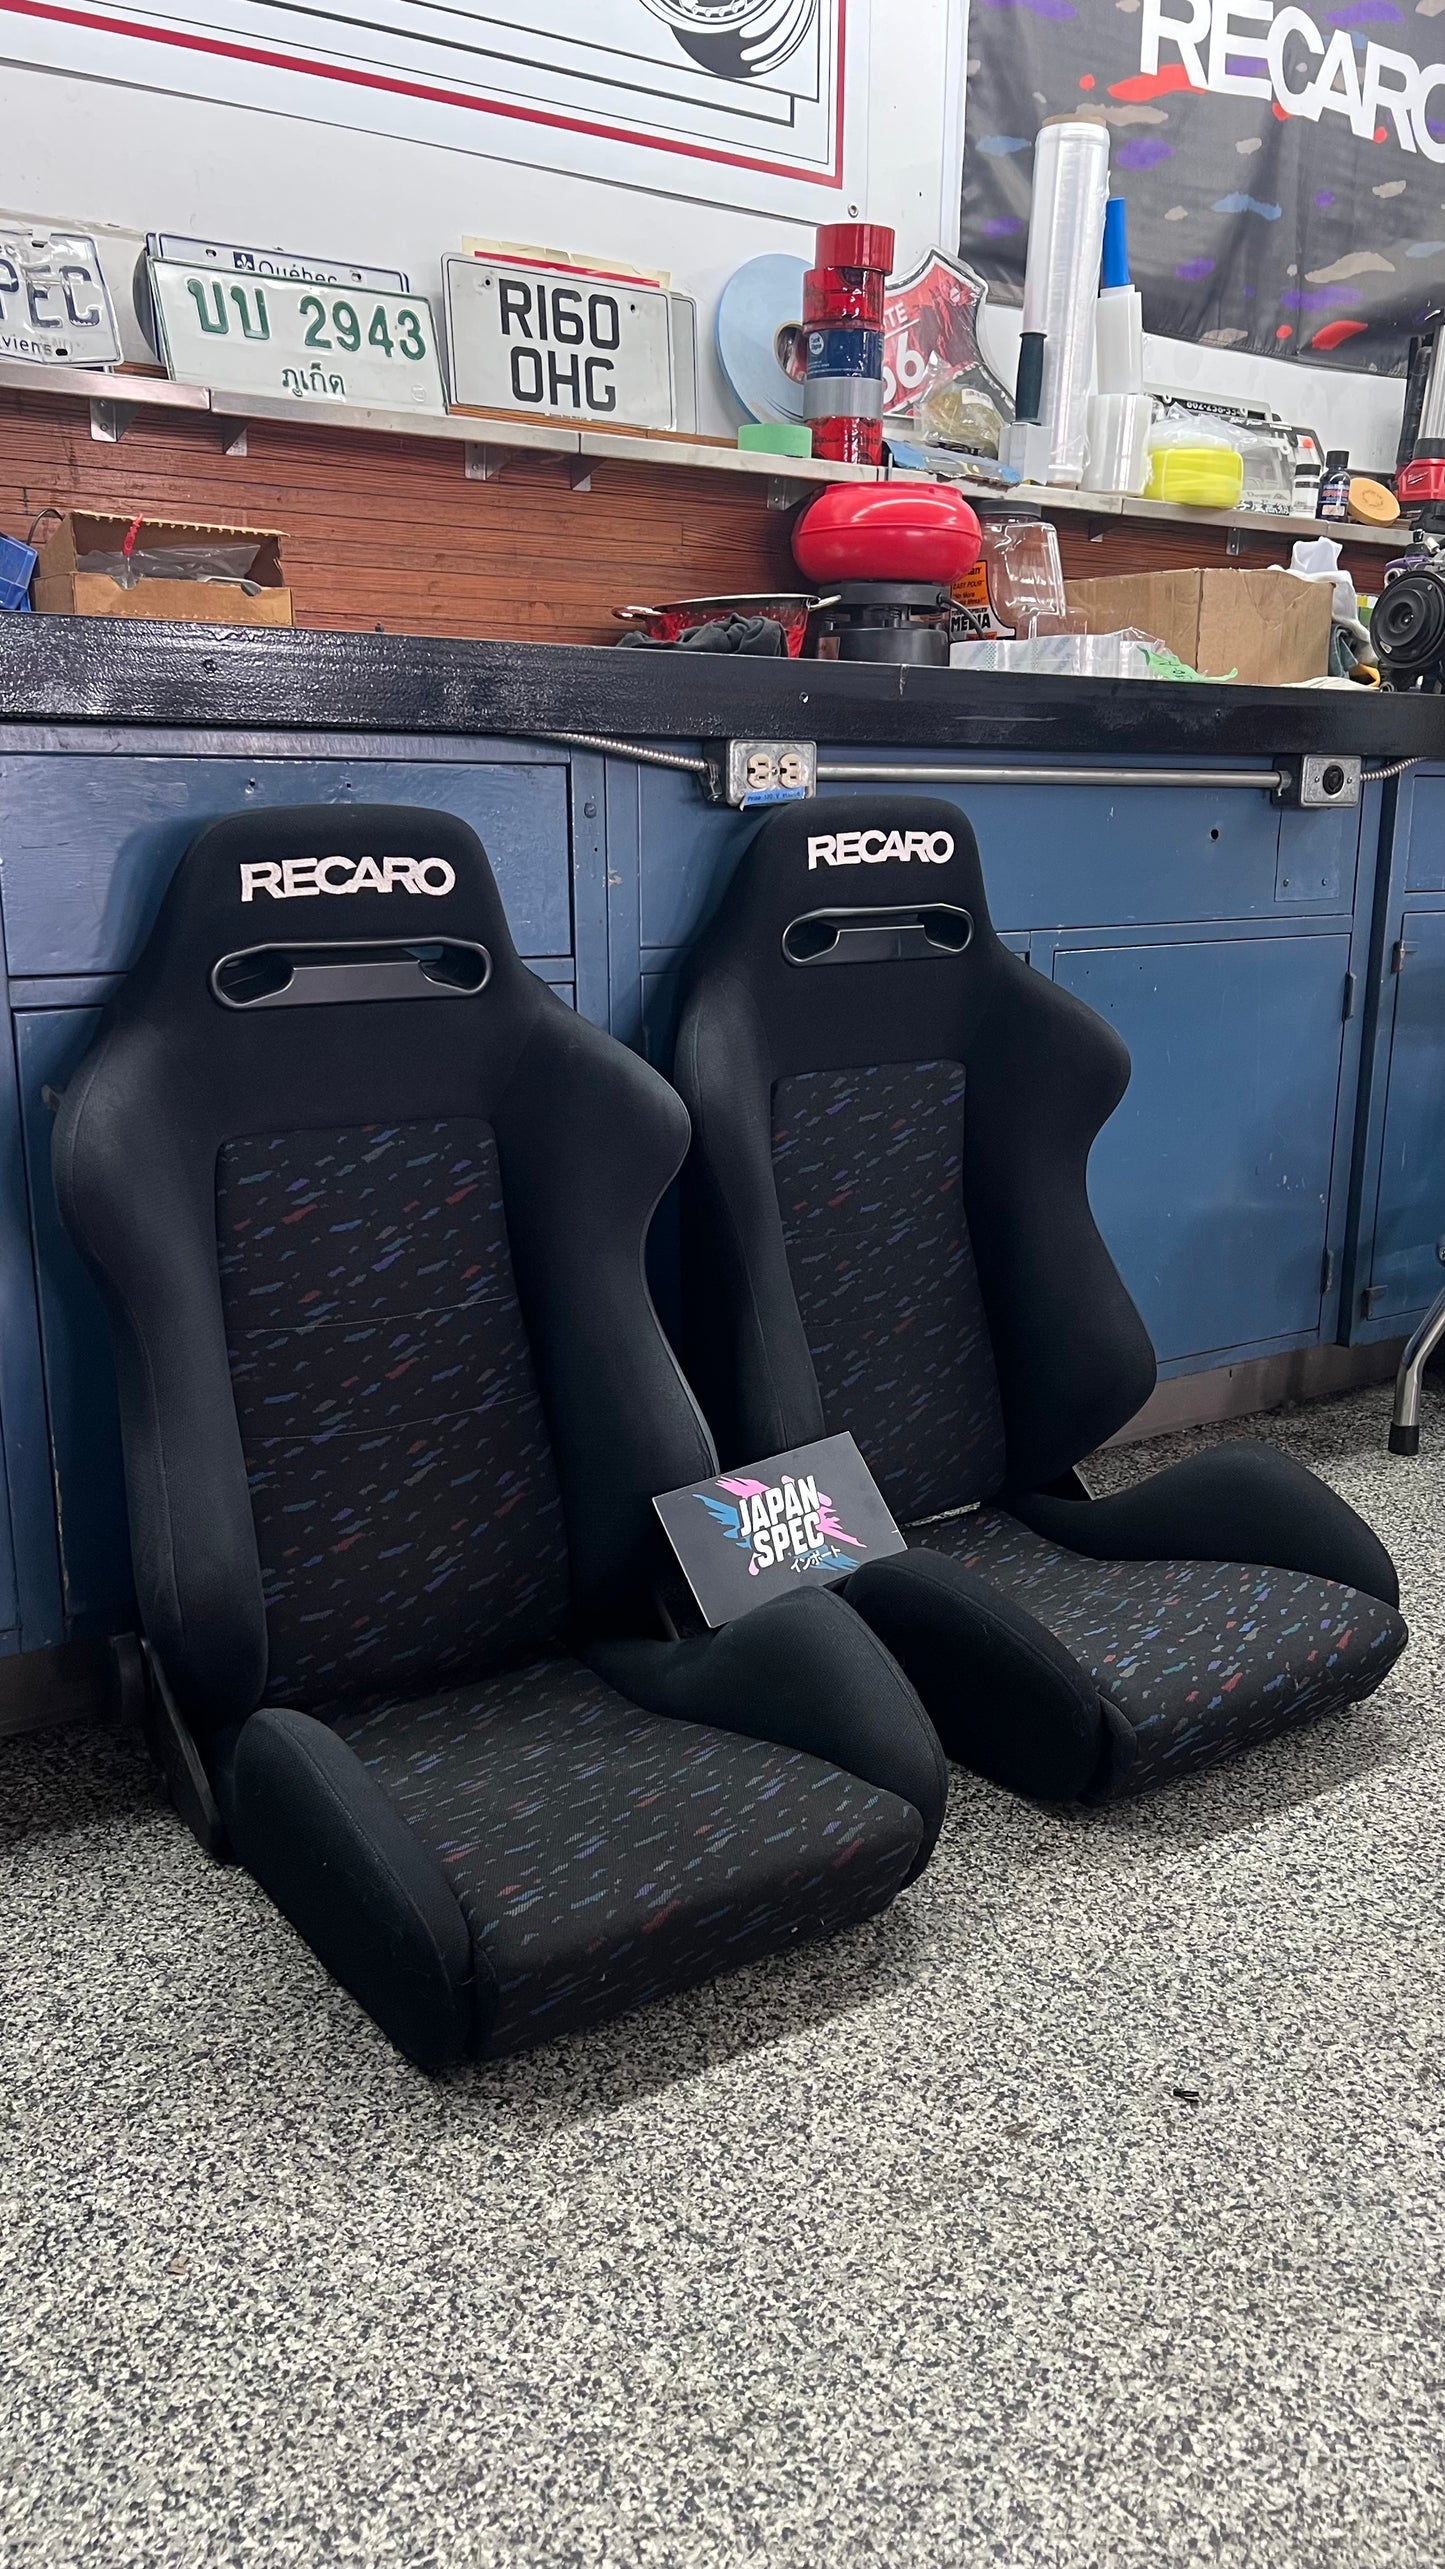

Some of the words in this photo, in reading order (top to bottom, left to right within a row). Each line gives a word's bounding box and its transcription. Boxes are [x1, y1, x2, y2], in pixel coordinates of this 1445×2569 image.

[299, 295, 427, 360] 2943
[499, 278, 620, 350] R160
[282, 362, 345, 397] ภูเก็ต
[510, 346, 617, 412] OHG
[807, 829, 955, 870] RECARO
[240, 855, 456, 902] RECARO
[739, 1475, 820, 1537] JAPAN
[753, 1511, 825, 1568] SPEC
[790, 1545, 841, 1573] インポート
